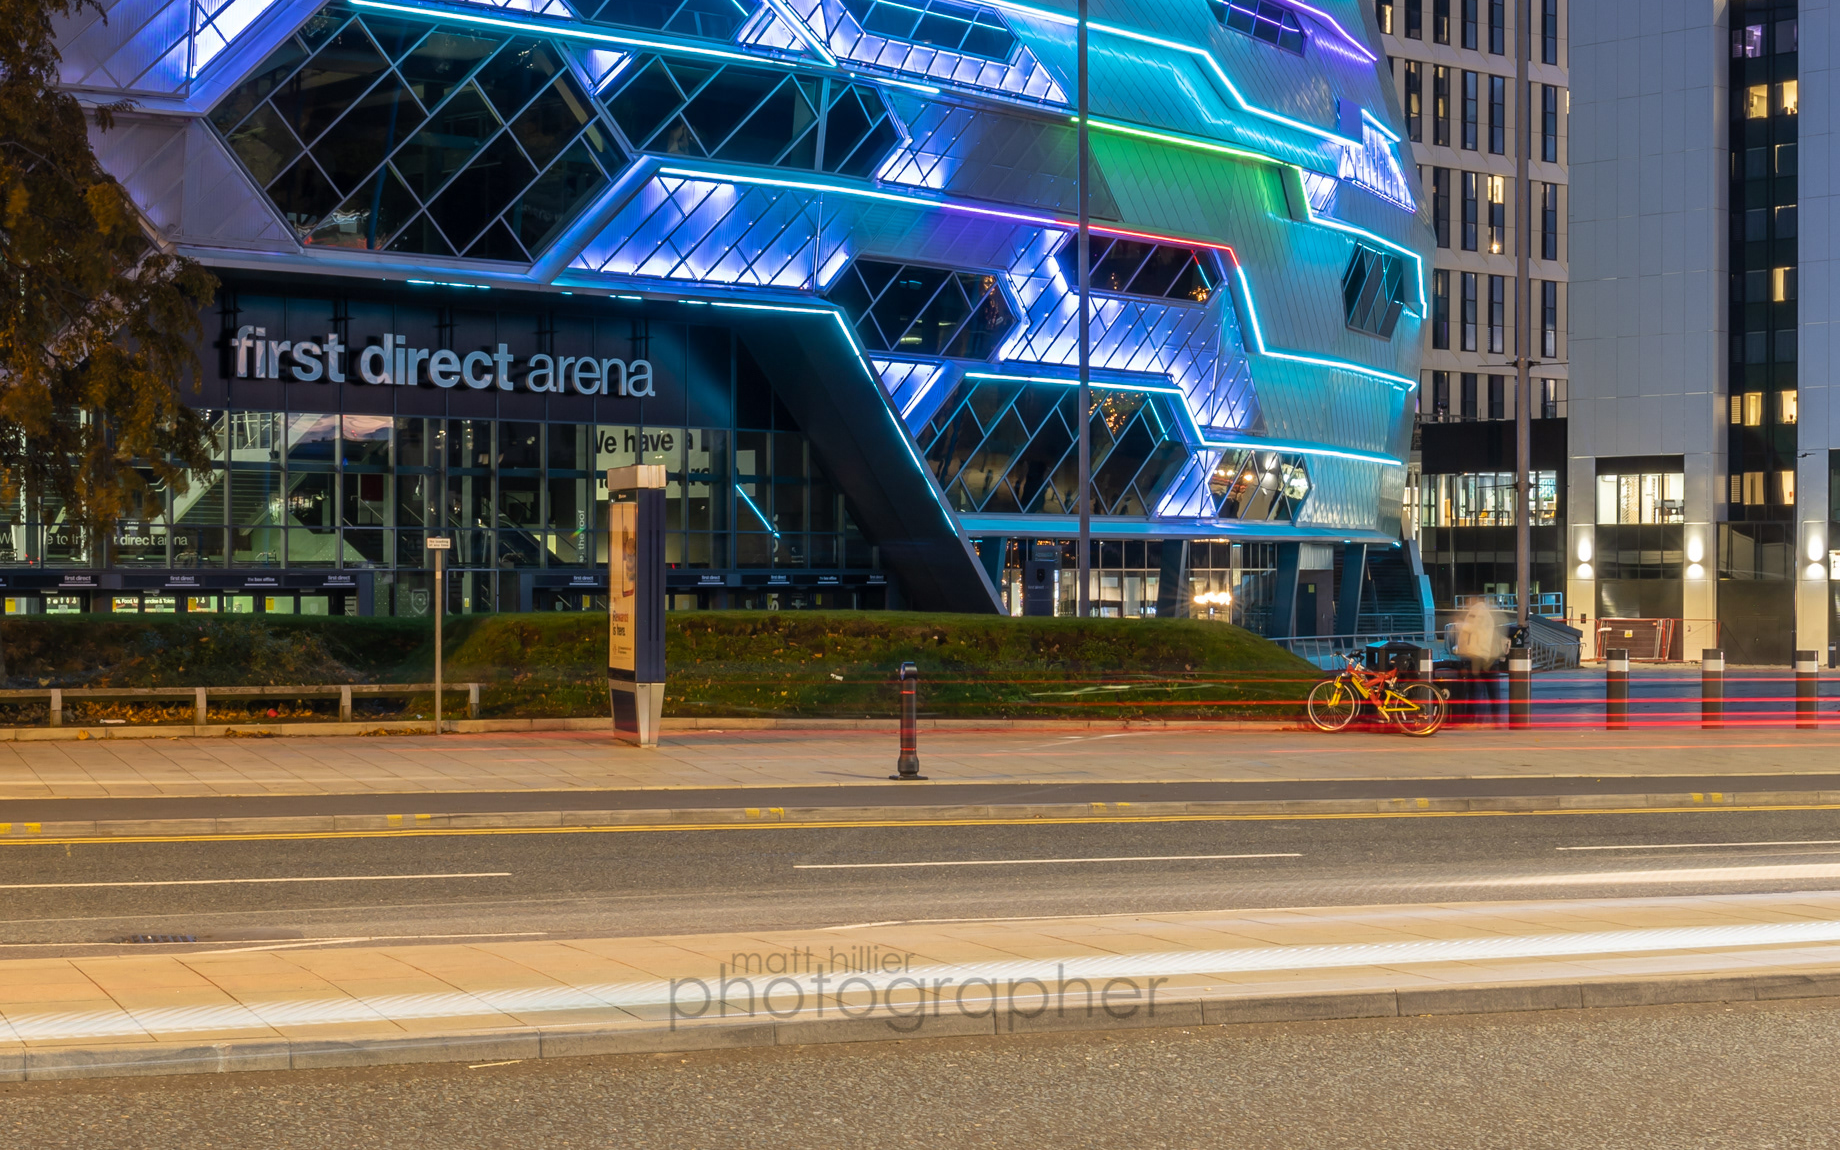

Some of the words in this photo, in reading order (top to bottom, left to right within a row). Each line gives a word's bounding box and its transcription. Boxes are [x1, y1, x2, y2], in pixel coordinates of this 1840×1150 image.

[231, 324, 345, 383] first
[359, 333, 514, 391] direct
[525, 353, 656, 397] arena
[624, 429, 674, 453] have
[120, 534, 156, 546] direct
